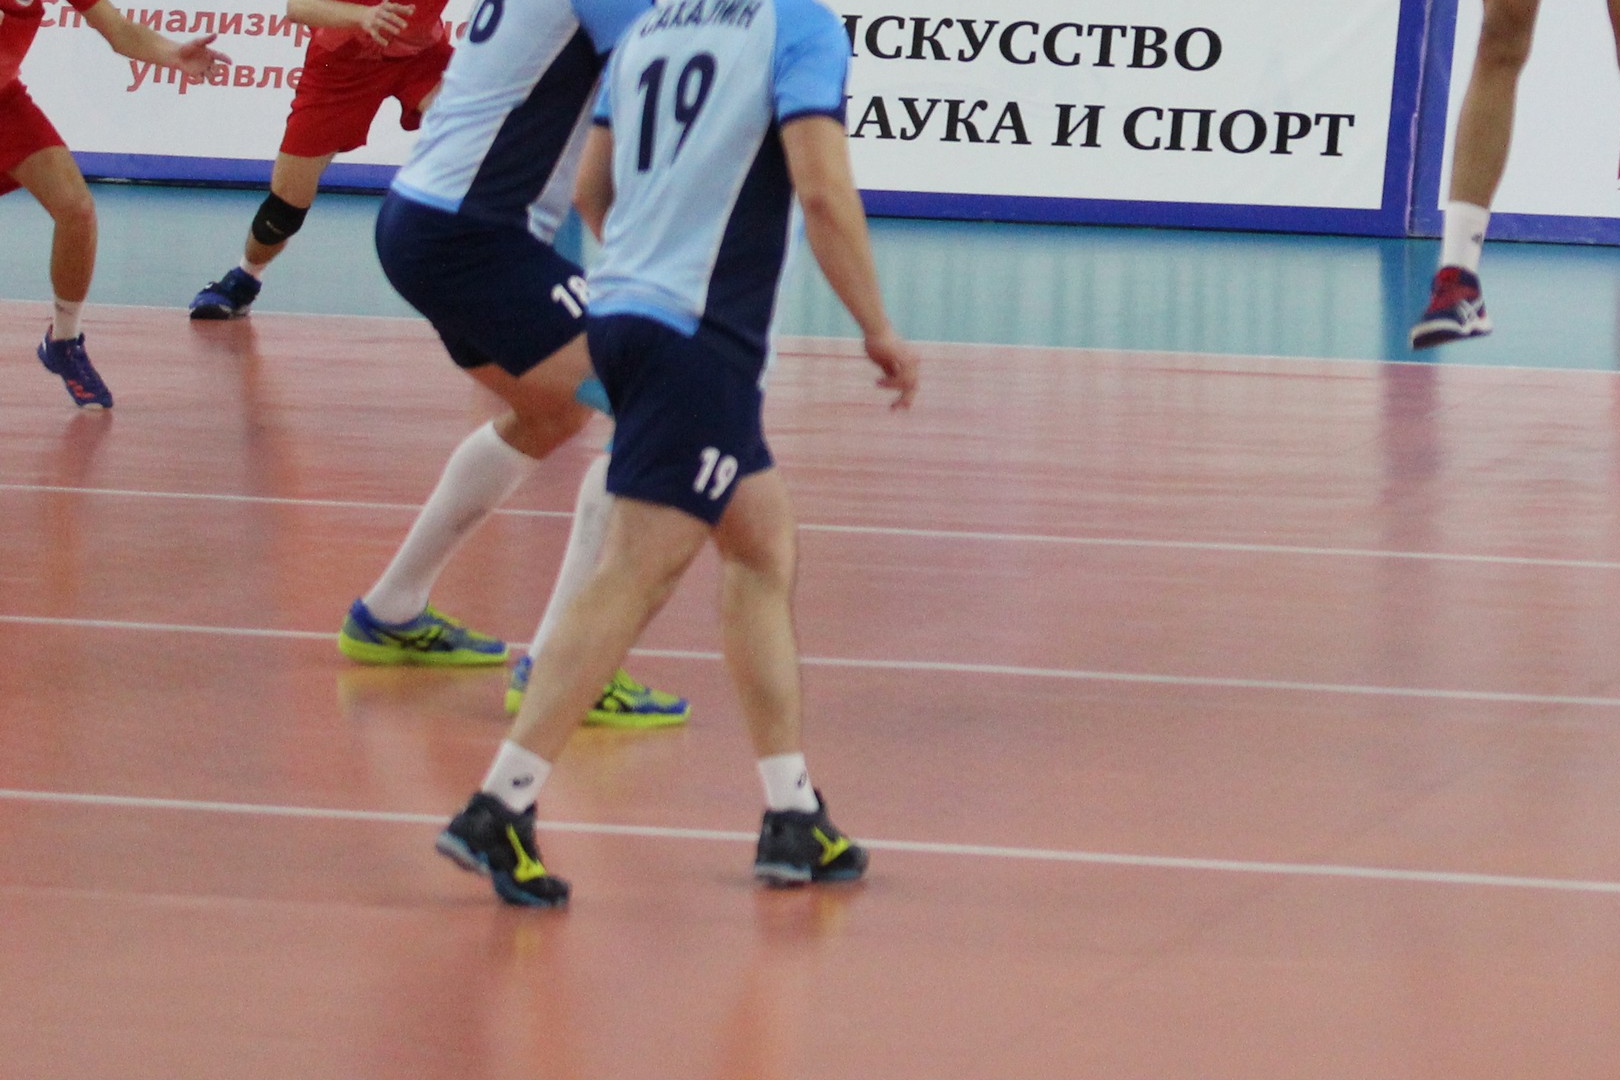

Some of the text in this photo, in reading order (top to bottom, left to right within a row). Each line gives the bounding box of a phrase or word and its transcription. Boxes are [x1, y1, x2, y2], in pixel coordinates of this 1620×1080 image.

[636, 52, 718, 175] 19
[845, 94, 1356, 157] АУКА И СПОРТ
[693, 445, 739, 500] 19
